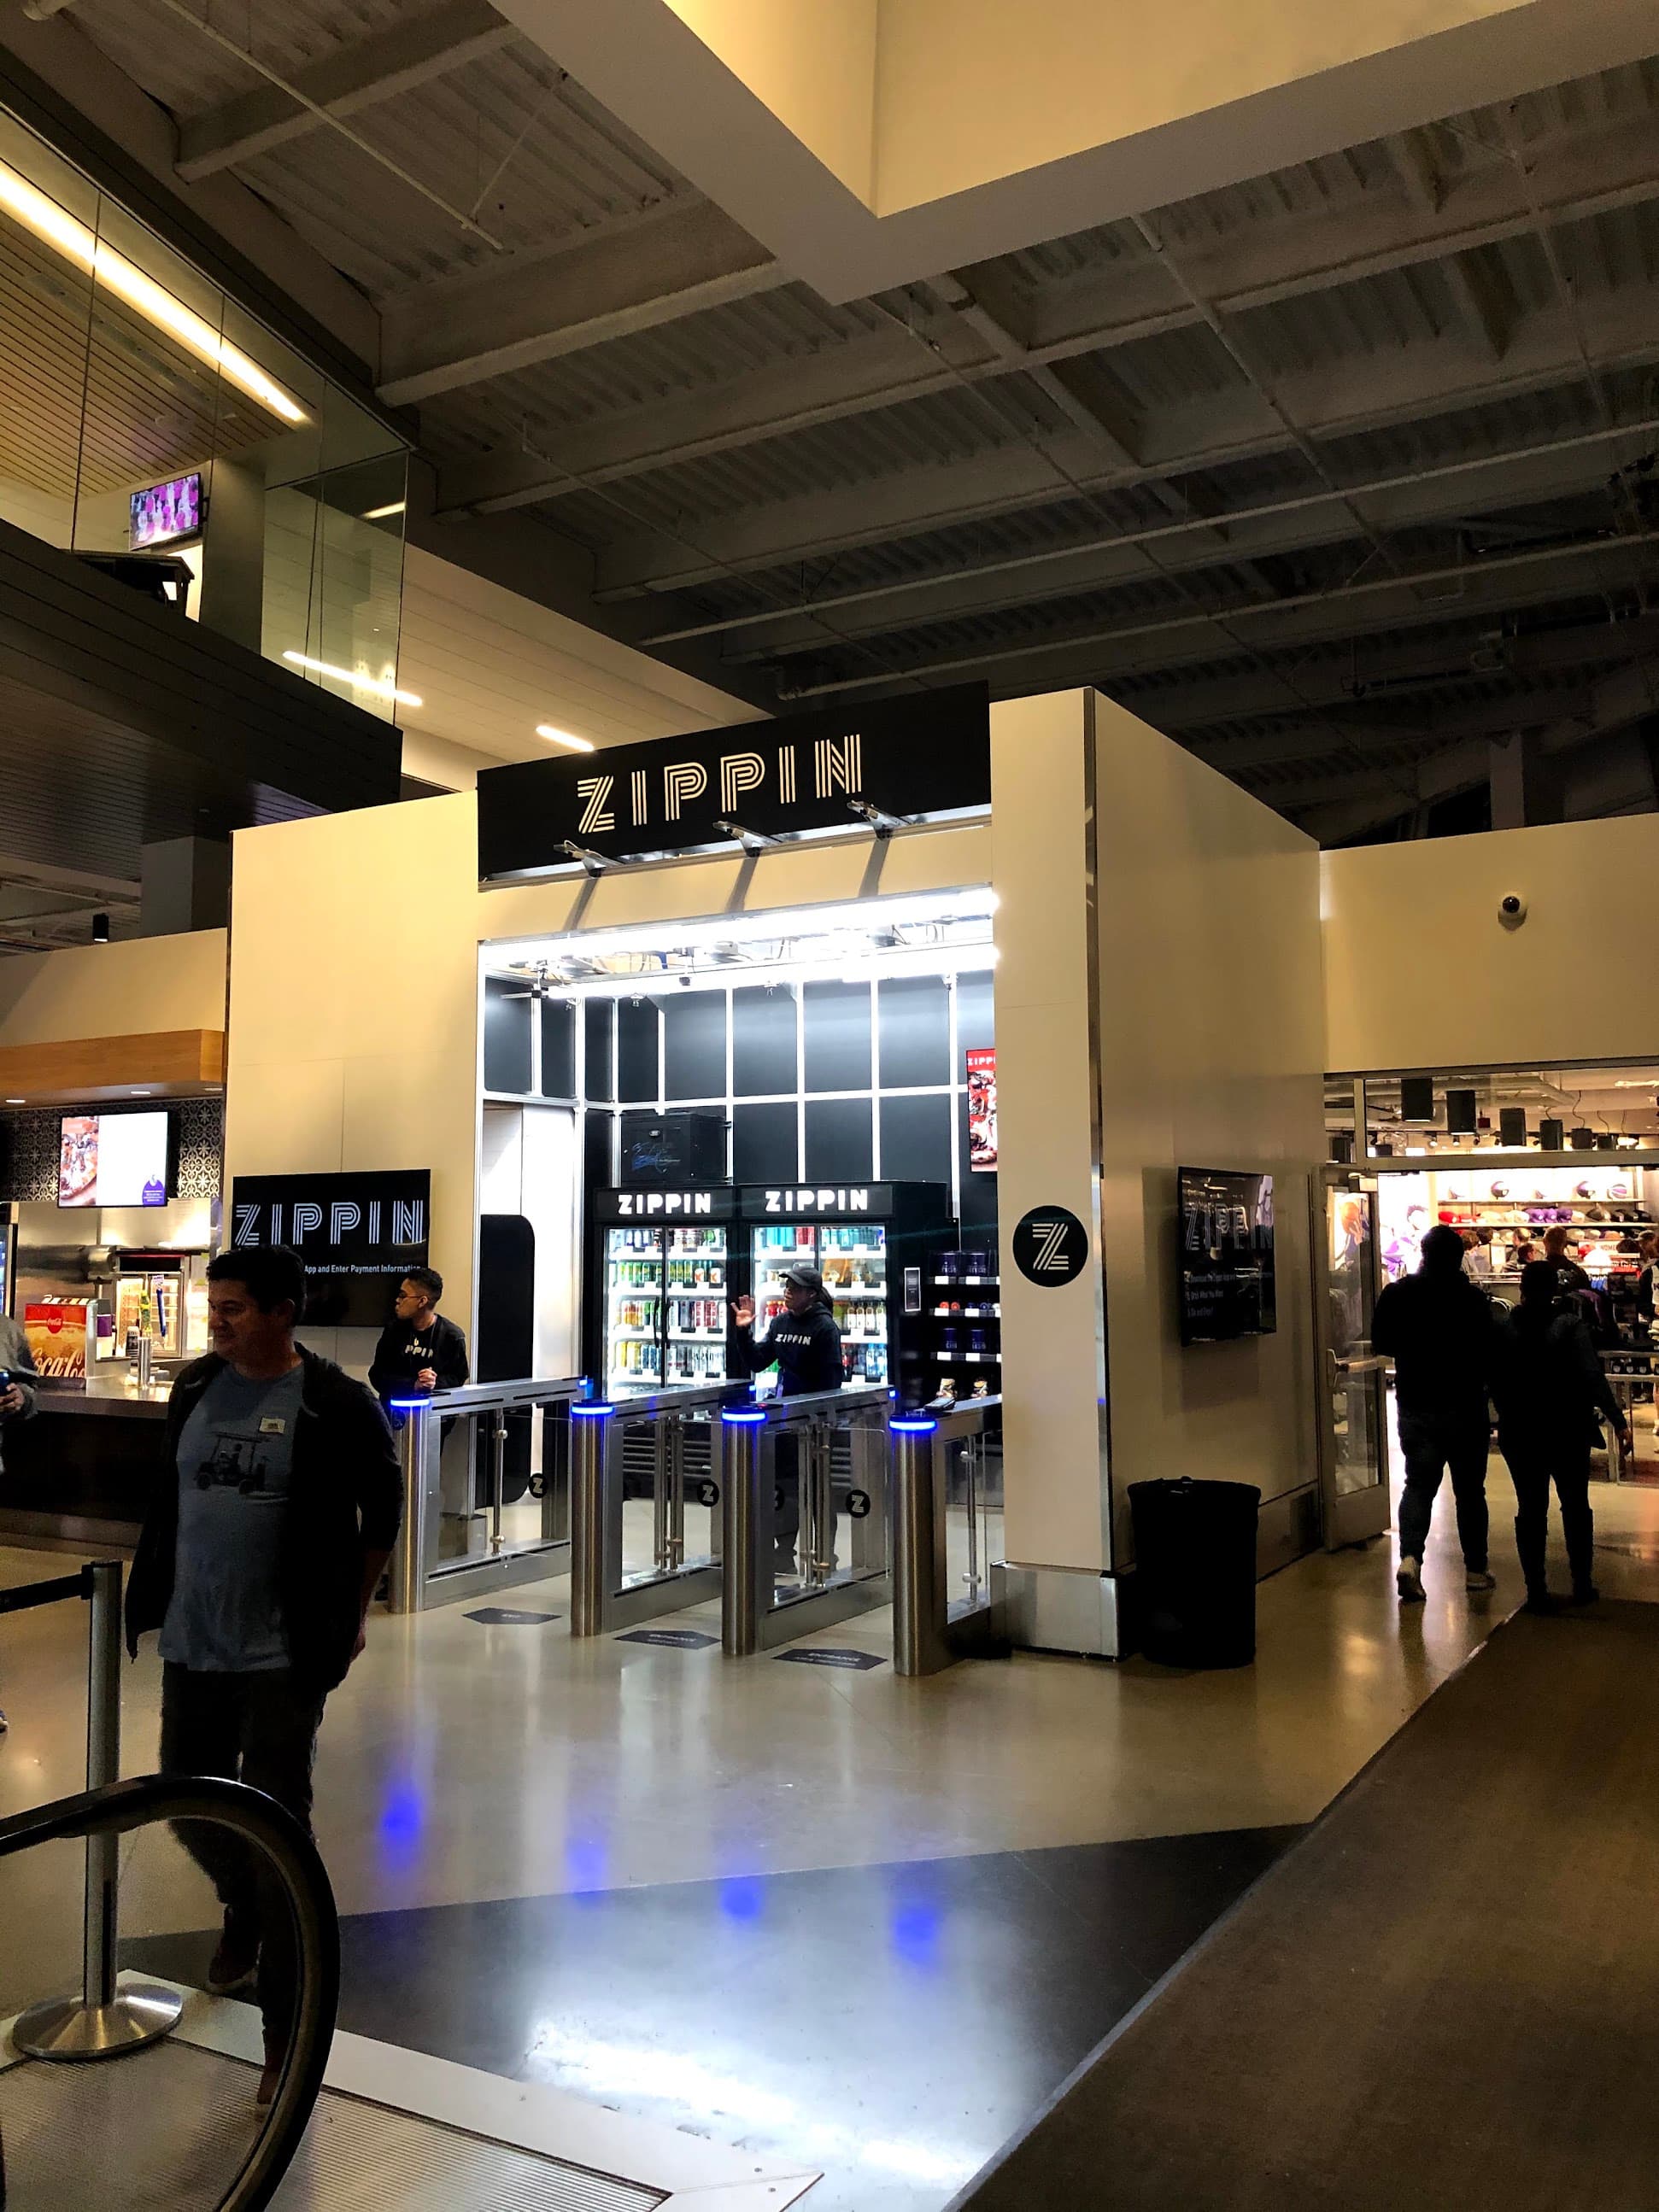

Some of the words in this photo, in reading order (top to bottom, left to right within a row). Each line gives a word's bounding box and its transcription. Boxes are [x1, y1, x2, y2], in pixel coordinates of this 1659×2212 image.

[577, 734, 862, 834] ZIPPIN
[618, 1192, 711, 1214] ZIPPIN
[765, 1189, 868, 1212] ZIPPIN
[234, 1199, 424, 1246] ZIPPIN
[1031, 1222, 1070, 1271] Z
[304, 1264, 316, 1274] App
[318, 1264, 330, 1273] and
[331, 1264, 349, 1273] Enter
[350, 1264, 379, 1274] Payment
[775, 1333, 812, 1345] ZIPPIN
